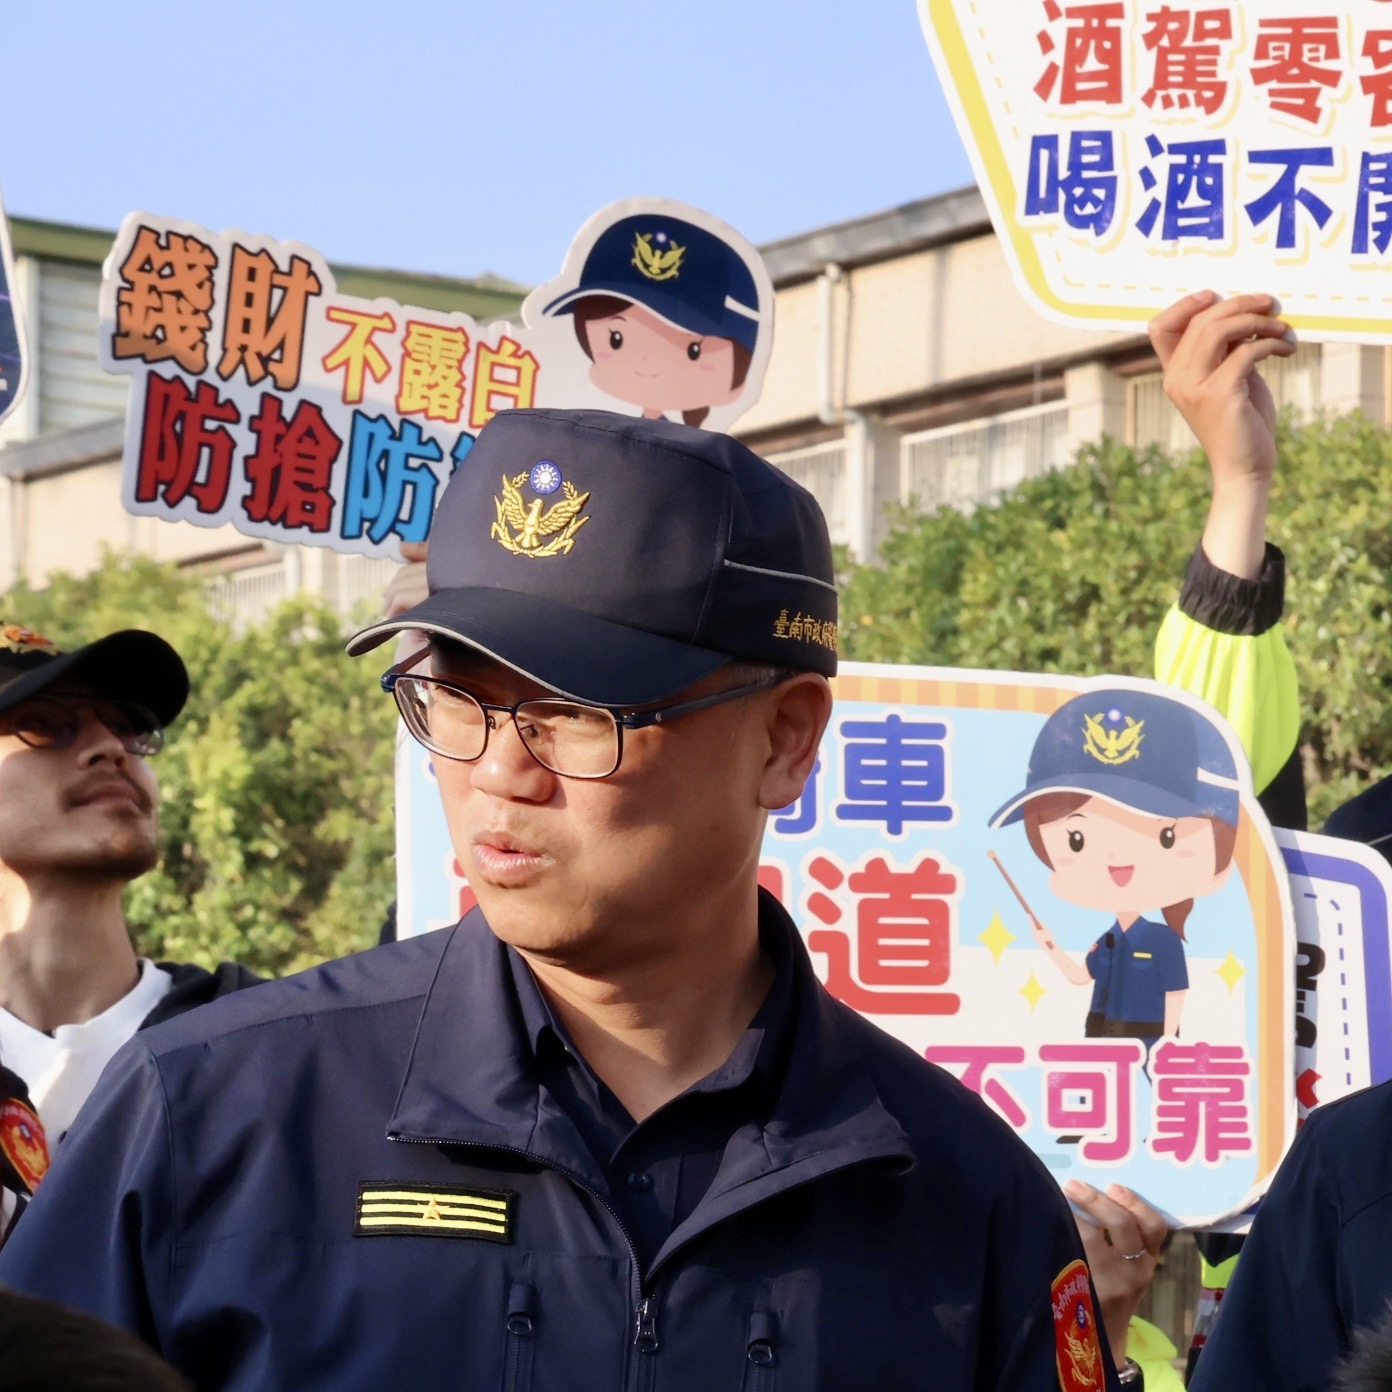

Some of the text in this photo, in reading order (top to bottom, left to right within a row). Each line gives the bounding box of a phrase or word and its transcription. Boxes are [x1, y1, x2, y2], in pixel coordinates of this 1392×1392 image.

[111, 226, 541, 429] 錢財不露白
[135, 372, 478, 545] 防搶防
[926, 1042, 1253, 1162] 不可靠
